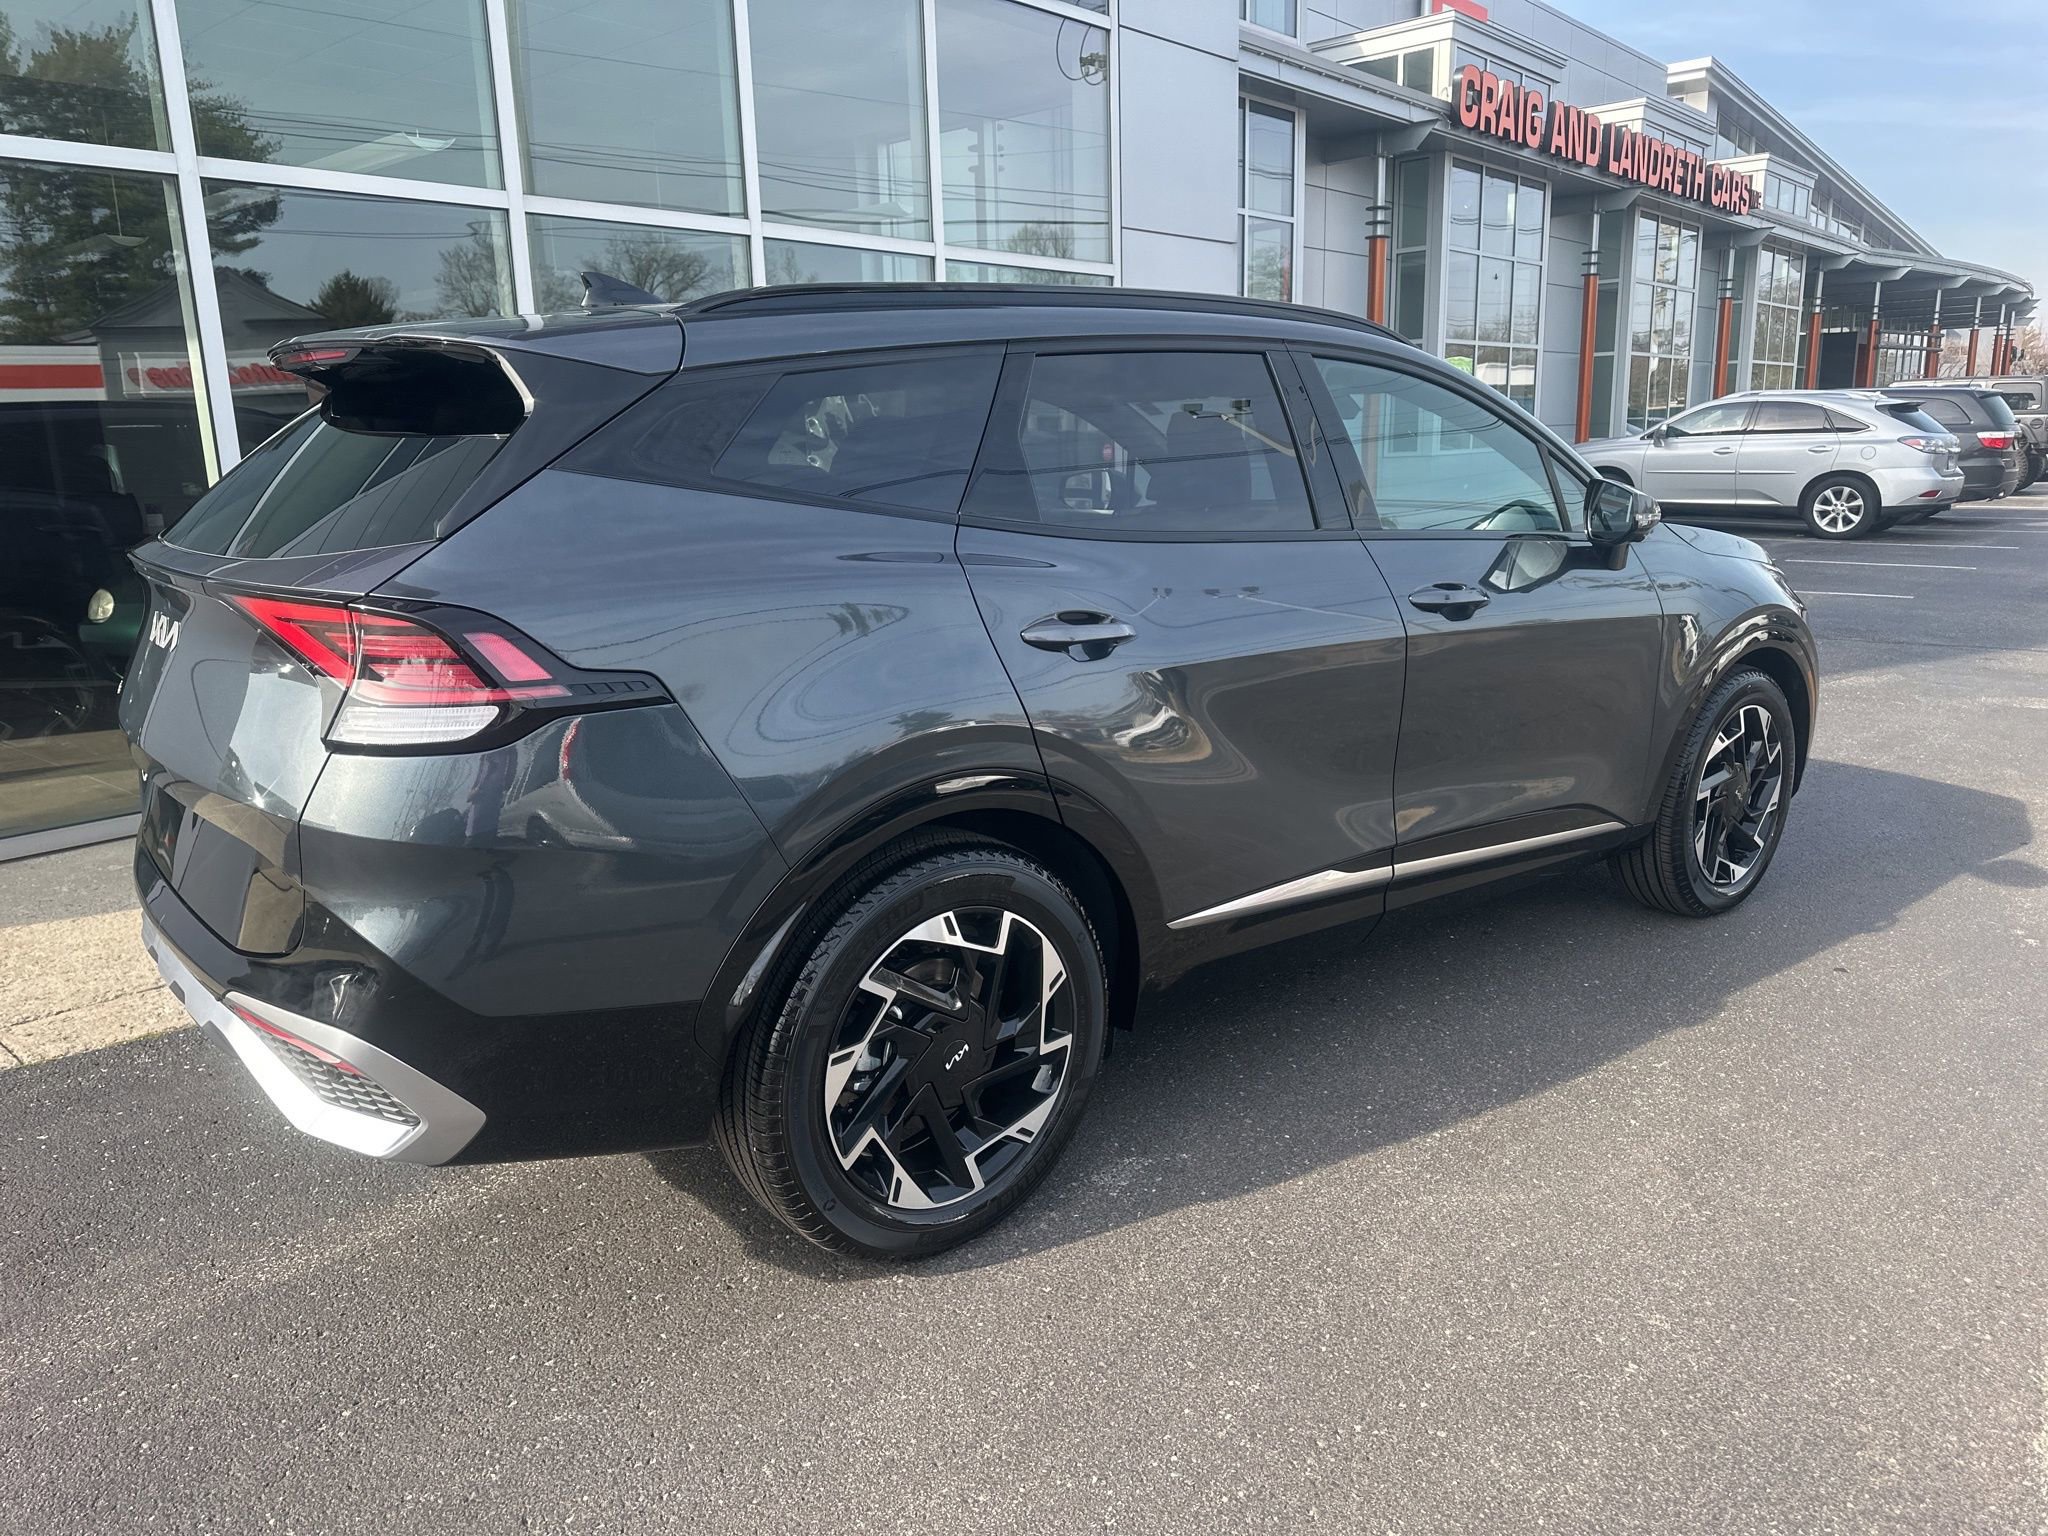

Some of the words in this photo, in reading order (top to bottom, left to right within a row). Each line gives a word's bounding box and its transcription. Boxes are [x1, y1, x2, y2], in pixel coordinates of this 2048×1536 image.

[1458, 64, 1544, 149] CRAIG
[1551, 101, 1600, 167] AND
[1608, 123, 1707, 202] LANDRETH
[1711, 163, 1750, 216] CARS
